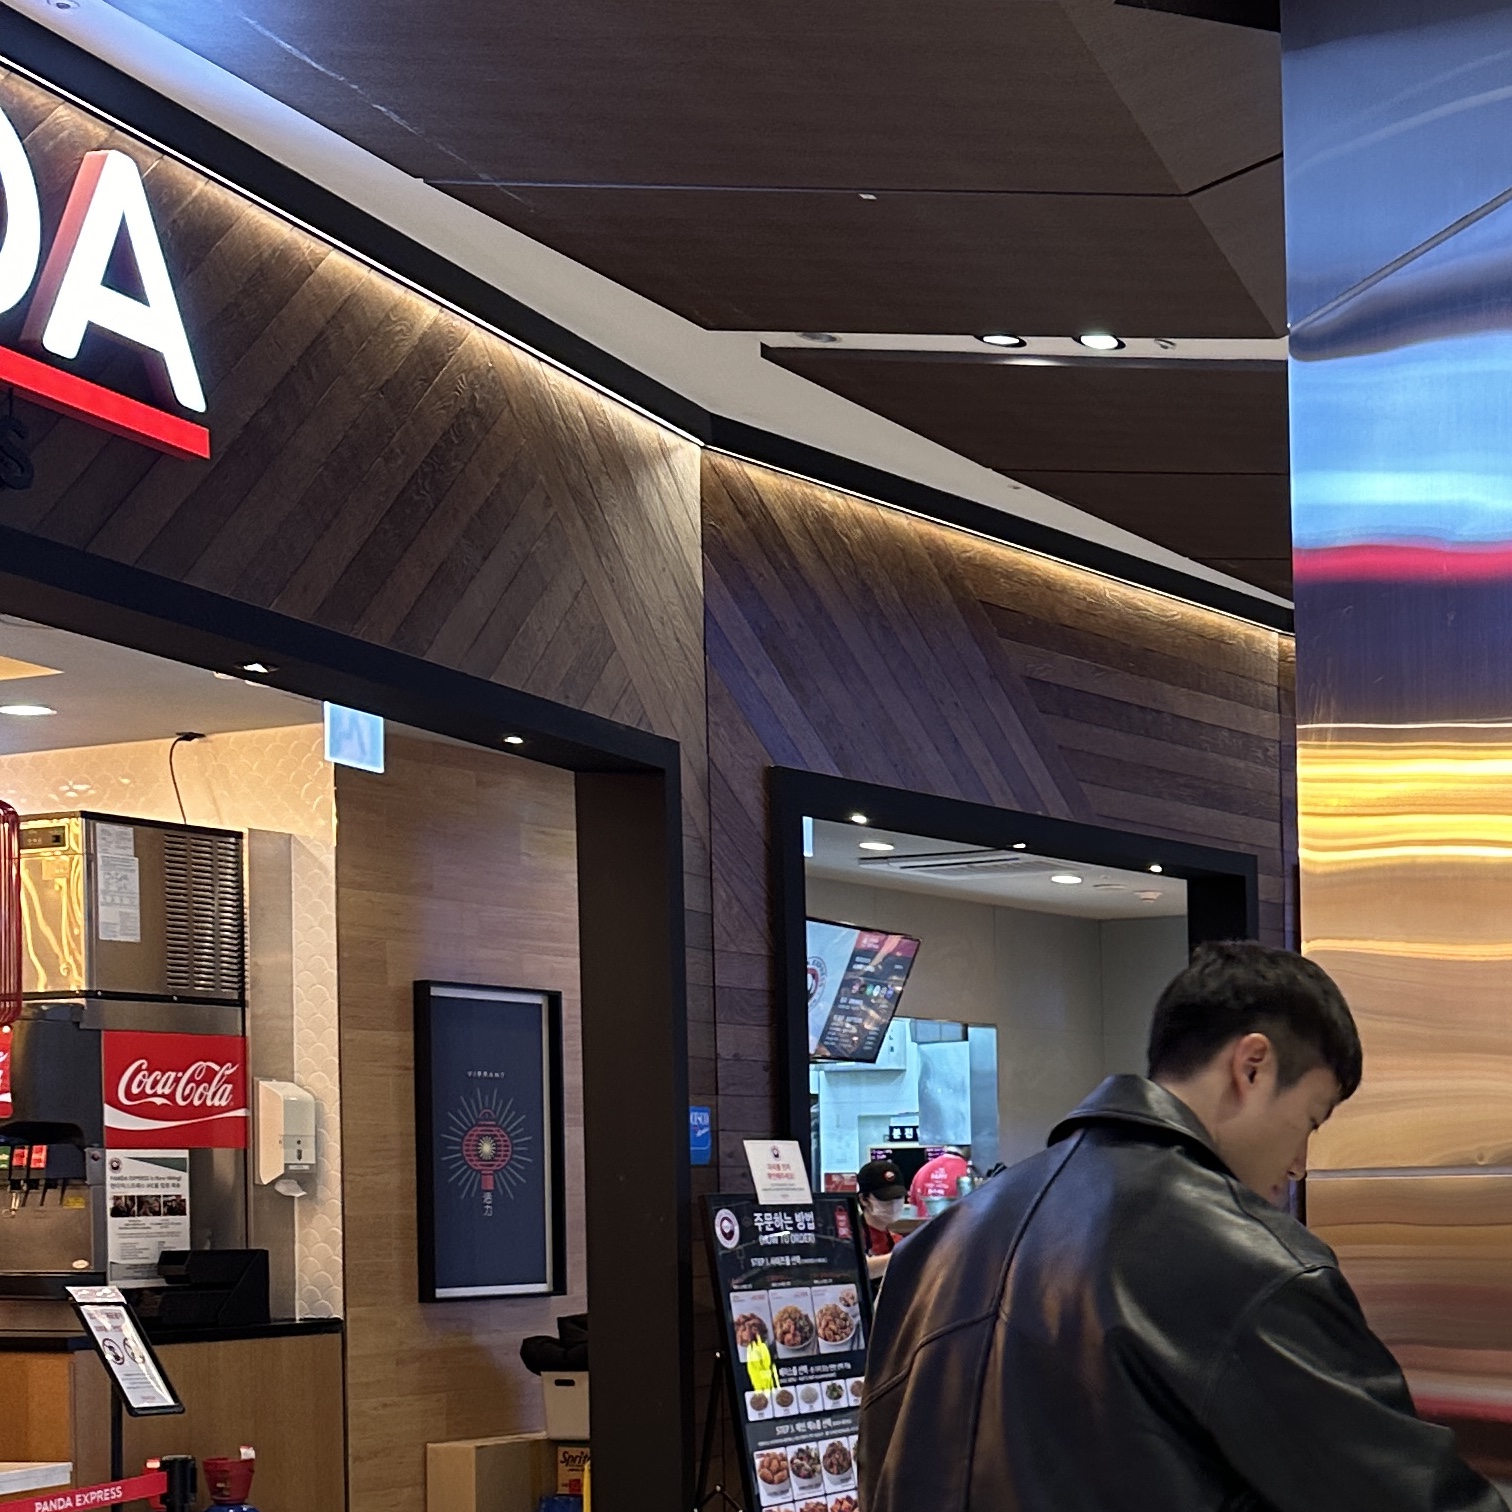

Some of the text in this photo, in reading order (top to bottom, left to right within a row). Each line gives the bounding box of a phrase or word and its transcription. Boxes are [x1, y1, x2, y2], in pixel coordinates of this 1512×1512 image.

[753, 1211, 794, 1232] 주문하는
[794, 1211, 816, 1231] 방법
[75, 1486, 123, 1507] EXPRESS
